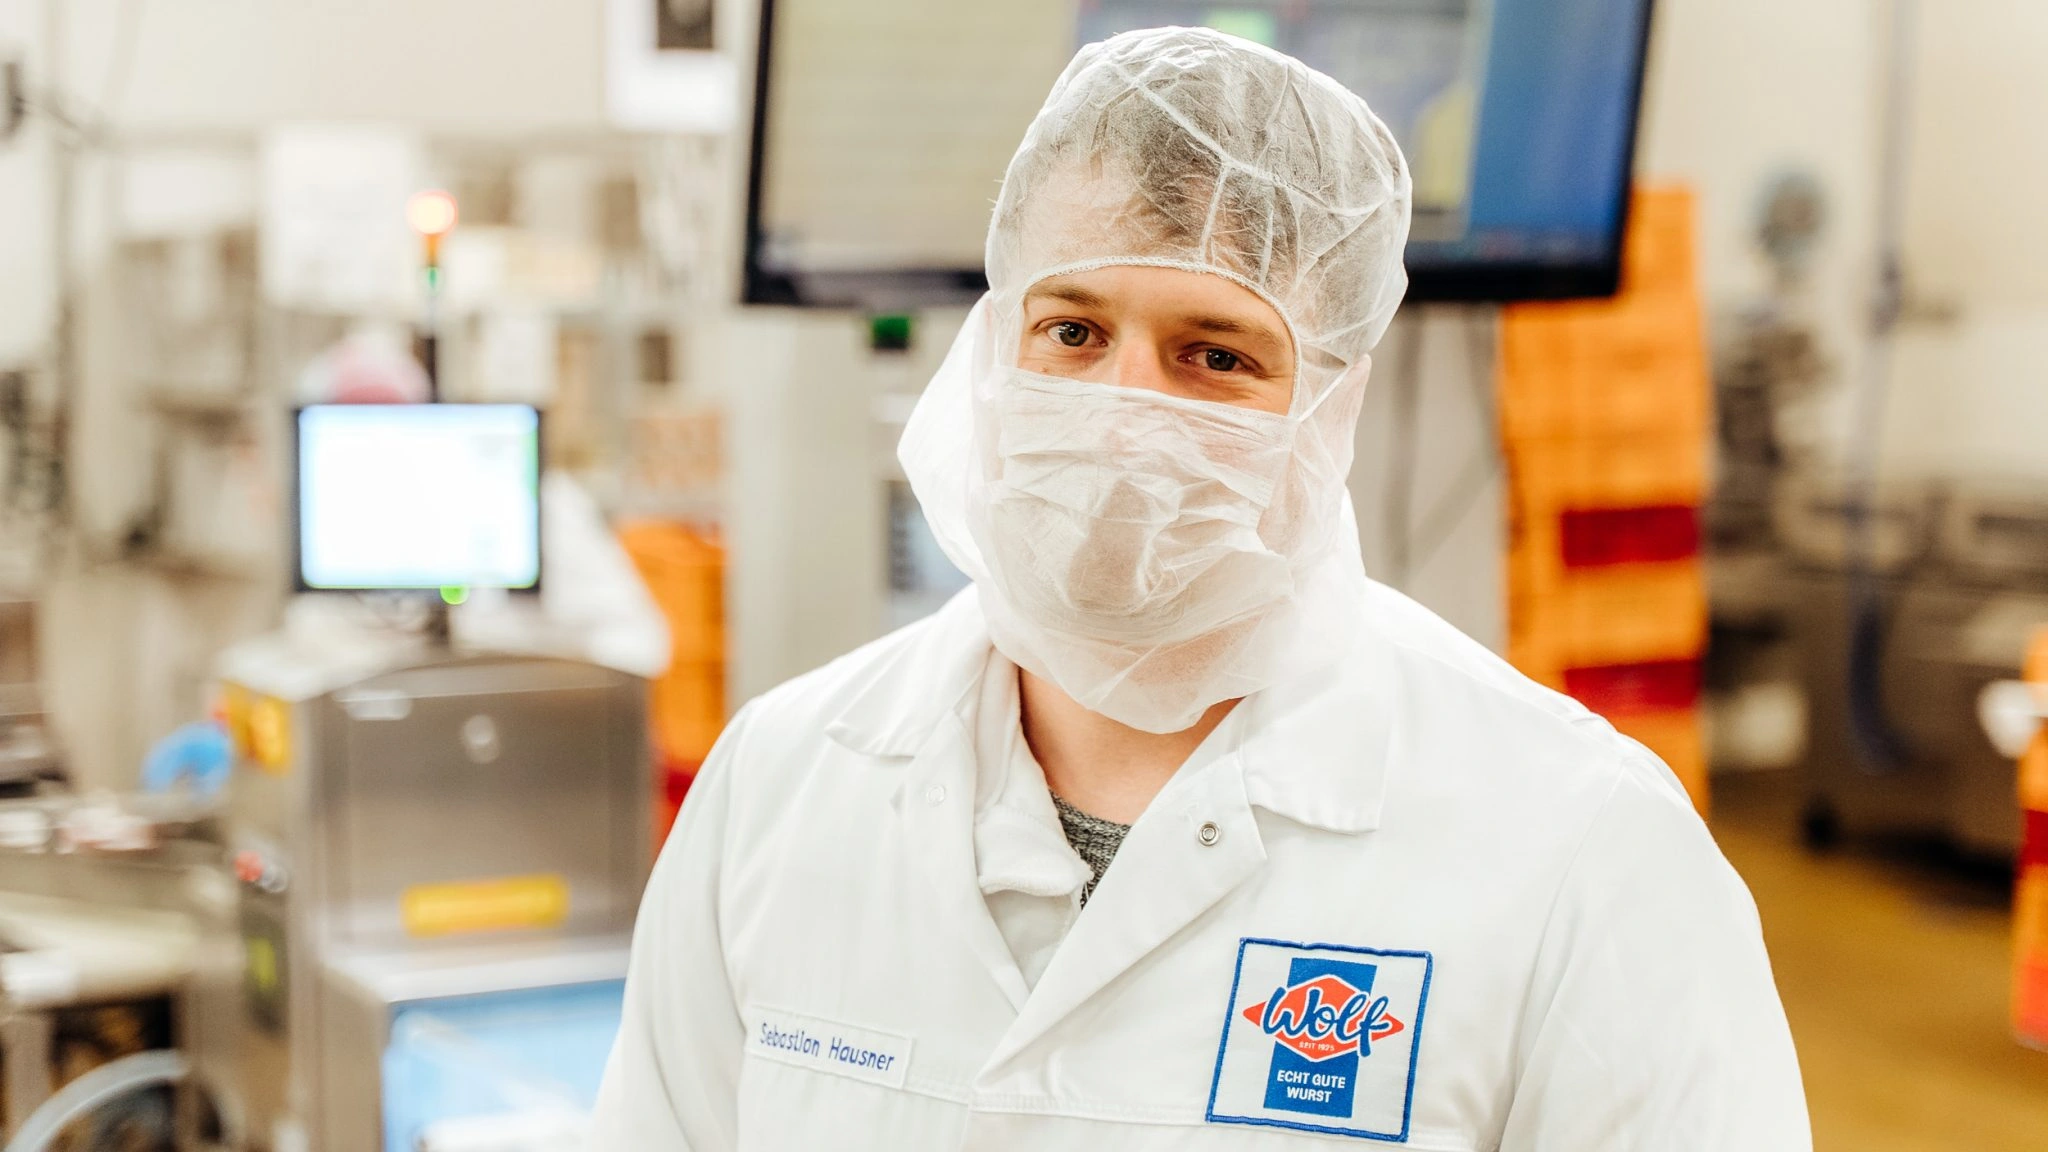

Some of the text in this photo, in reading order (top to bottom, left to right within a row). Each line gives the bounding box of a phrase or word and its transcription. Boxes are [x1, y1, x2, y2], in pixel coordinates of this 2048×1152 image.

[1262, 986, 1390, 1057] Wolf
[828, 1036, 895, 1072] Hausner
[1299, 1041, 1316, 1049] SEIT
[1277, 1070, 1346, 1089] ECHT GUTE
[1287, 1087, 1332, 1103] WURST
